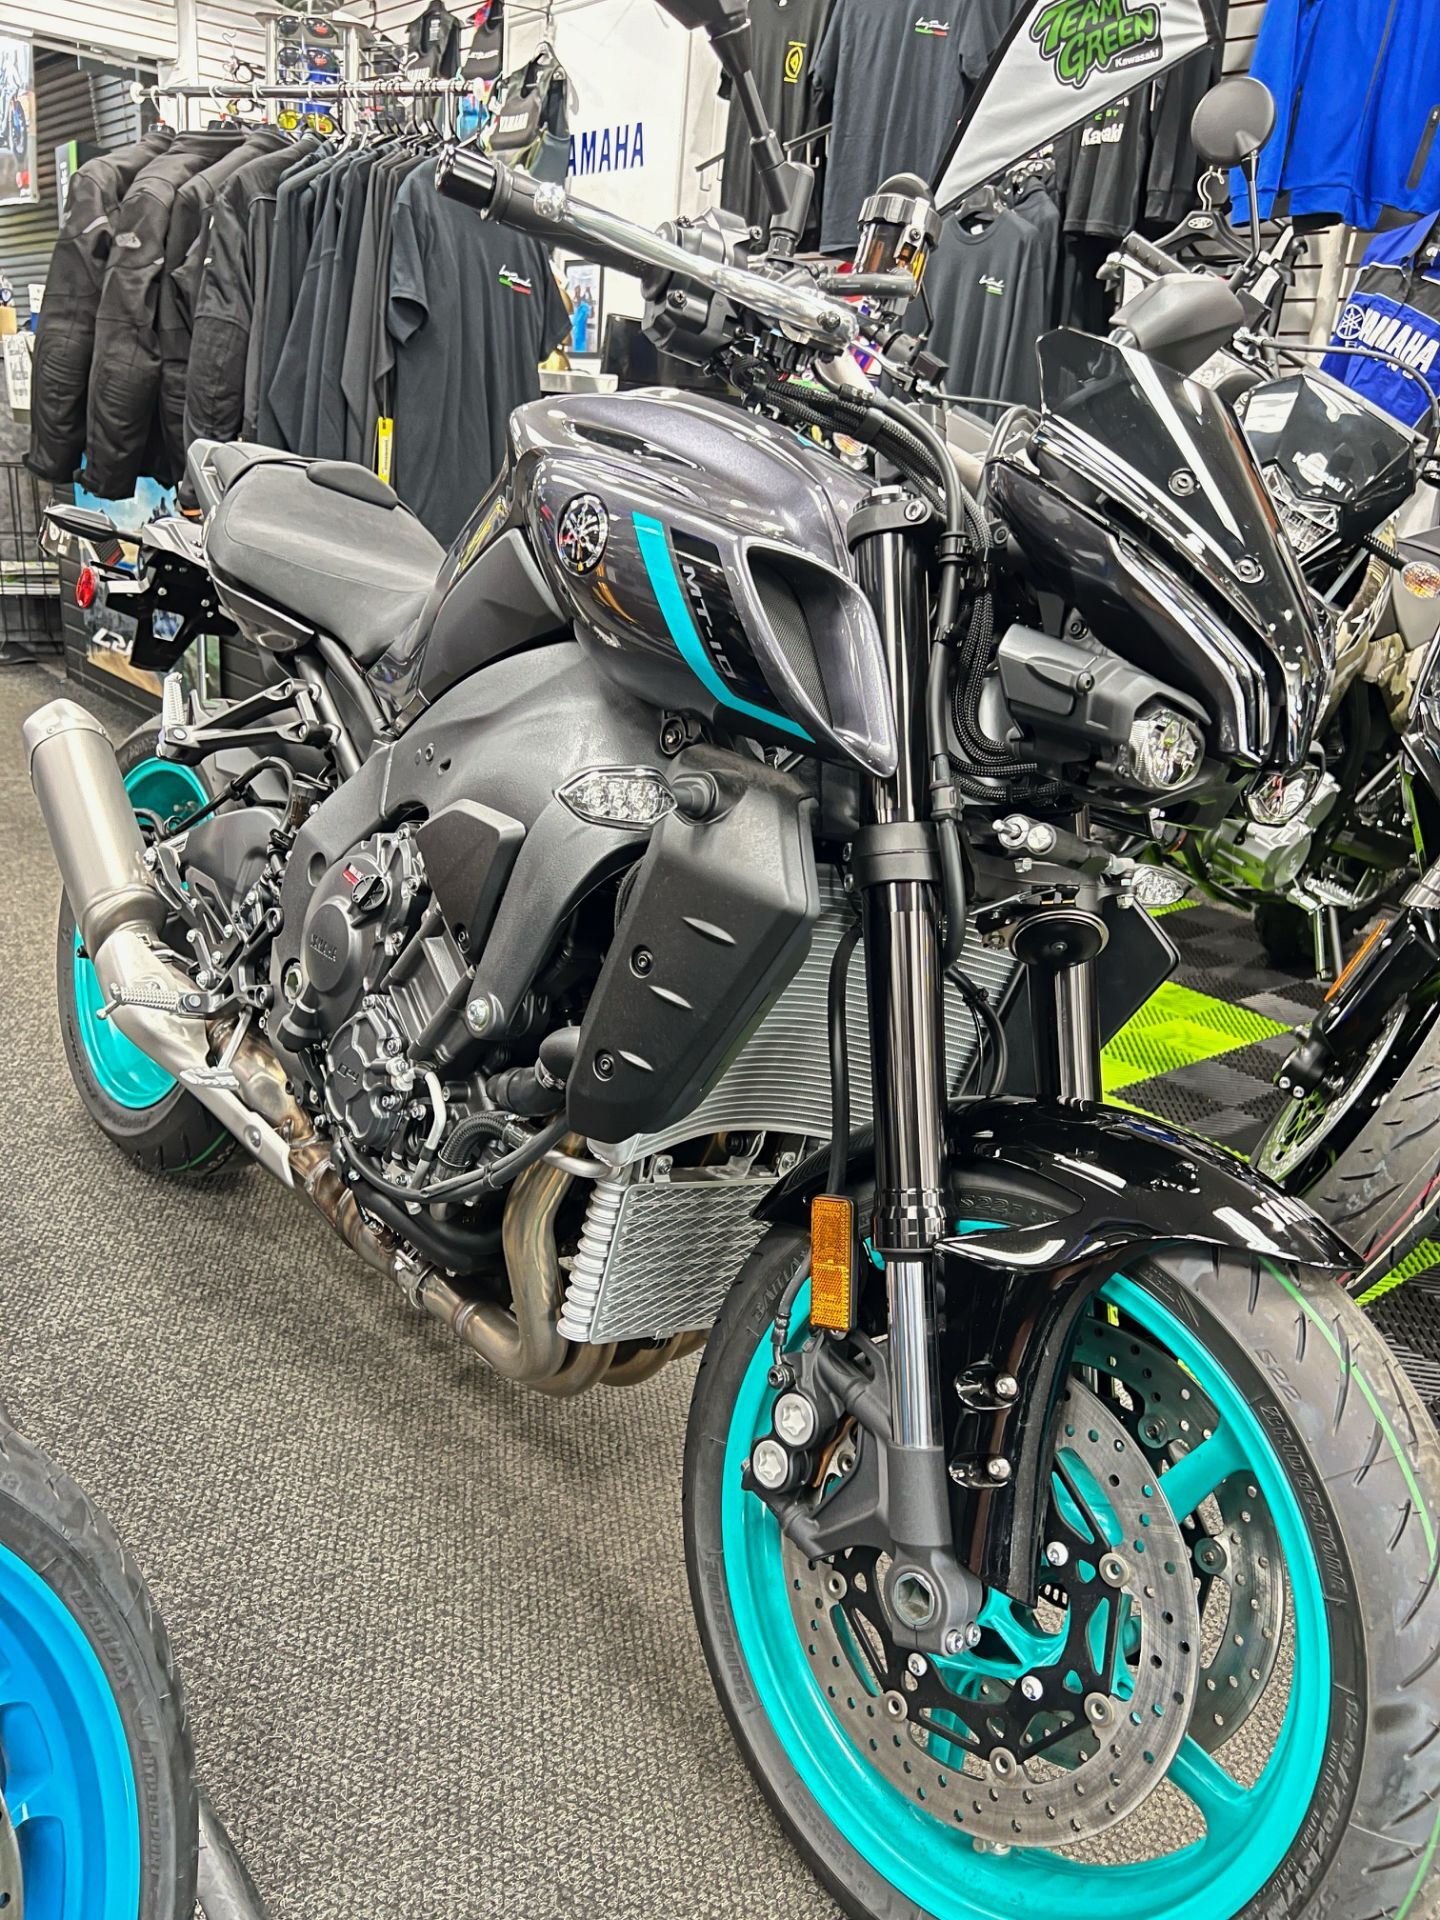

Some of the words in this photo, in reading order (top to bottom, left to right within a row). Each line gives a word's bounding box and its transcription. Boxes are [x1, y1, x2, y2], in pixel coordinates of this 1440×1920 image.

[1034, 0, 1122, 52] TEAM
[1060, 9, 1154, 81] GREEN
[1114, 48, 1159, 68] Kawasaki
[567, 121, 644, 177] AMAHA
[682, 564, 737, 679] MT-10
